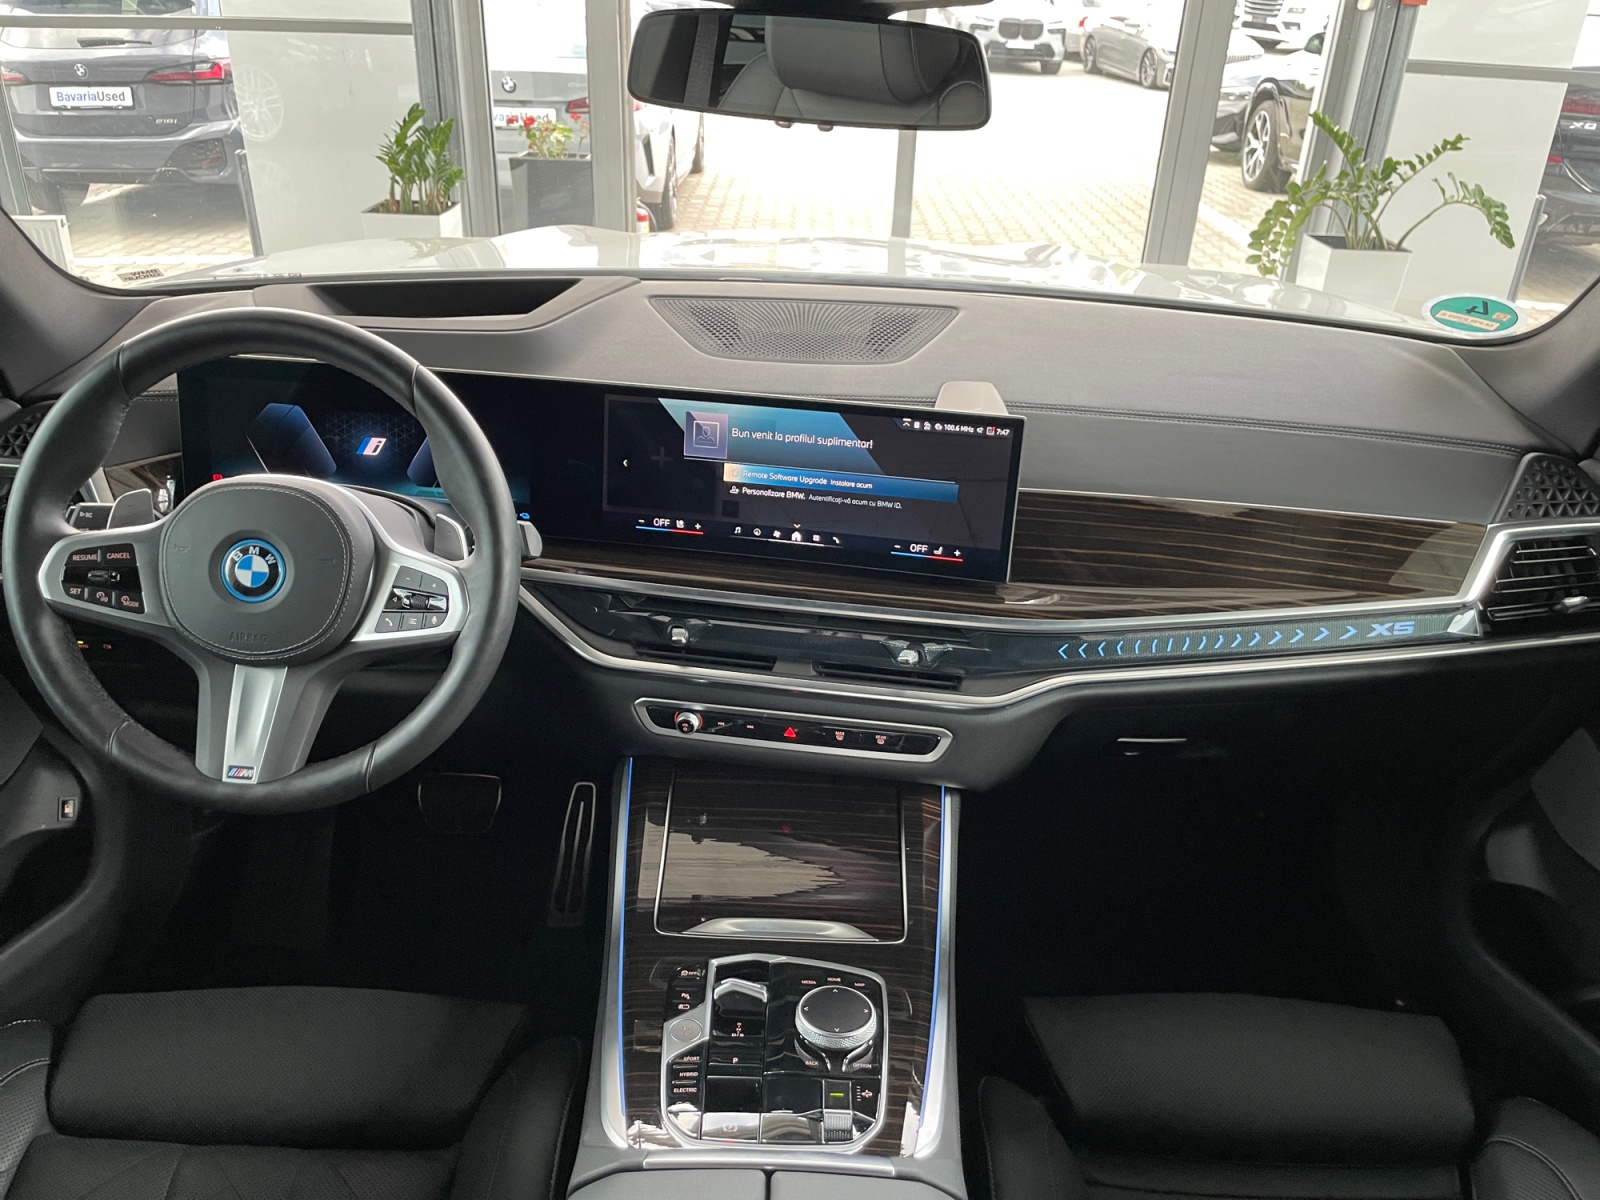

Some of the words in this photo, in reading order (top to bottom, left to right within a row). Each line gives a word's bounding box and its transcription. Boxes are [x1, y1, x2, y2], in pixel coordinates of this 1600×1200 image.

[56, 90, 126, 102] BavariaUsed
[943, 423, 960, 432] 100.6
[960, 425, 975, 433] MHz
[996, 428, 1010, 436] 7:47
[731, 427, 750, 438] Bun
[751, 430, 773, 441] venit
[774, 431, 783, 441] la
[785, 434, 815, 444] profilul
[817, 436, 873, 449] suplimentar!
[743, 469, 768, 479] Remote
[769, 472, 798, 482] Software
[799, 475, 828, 486] Upgrade
[830, 479, 855, 488] Instalare
[742, 486, 785, 498] Personalizare
[786, 490, 806, 500] BMW.
[877, 501, 893, 509] BMW
[653, 518, 671, 528] OFF
[909, 543, 928, 553] OFF
[72, 553, 98, 561] RESUME
[106, 552, 131, 560] CANCEL
[232, 546, 276, 565] BMW
[69, 587, 82, 595] SET
[122, 599, 140, 608] MODE
[1366, 621, 1415, 638] X5
[230, 631, 268, 644] AIRBAG
